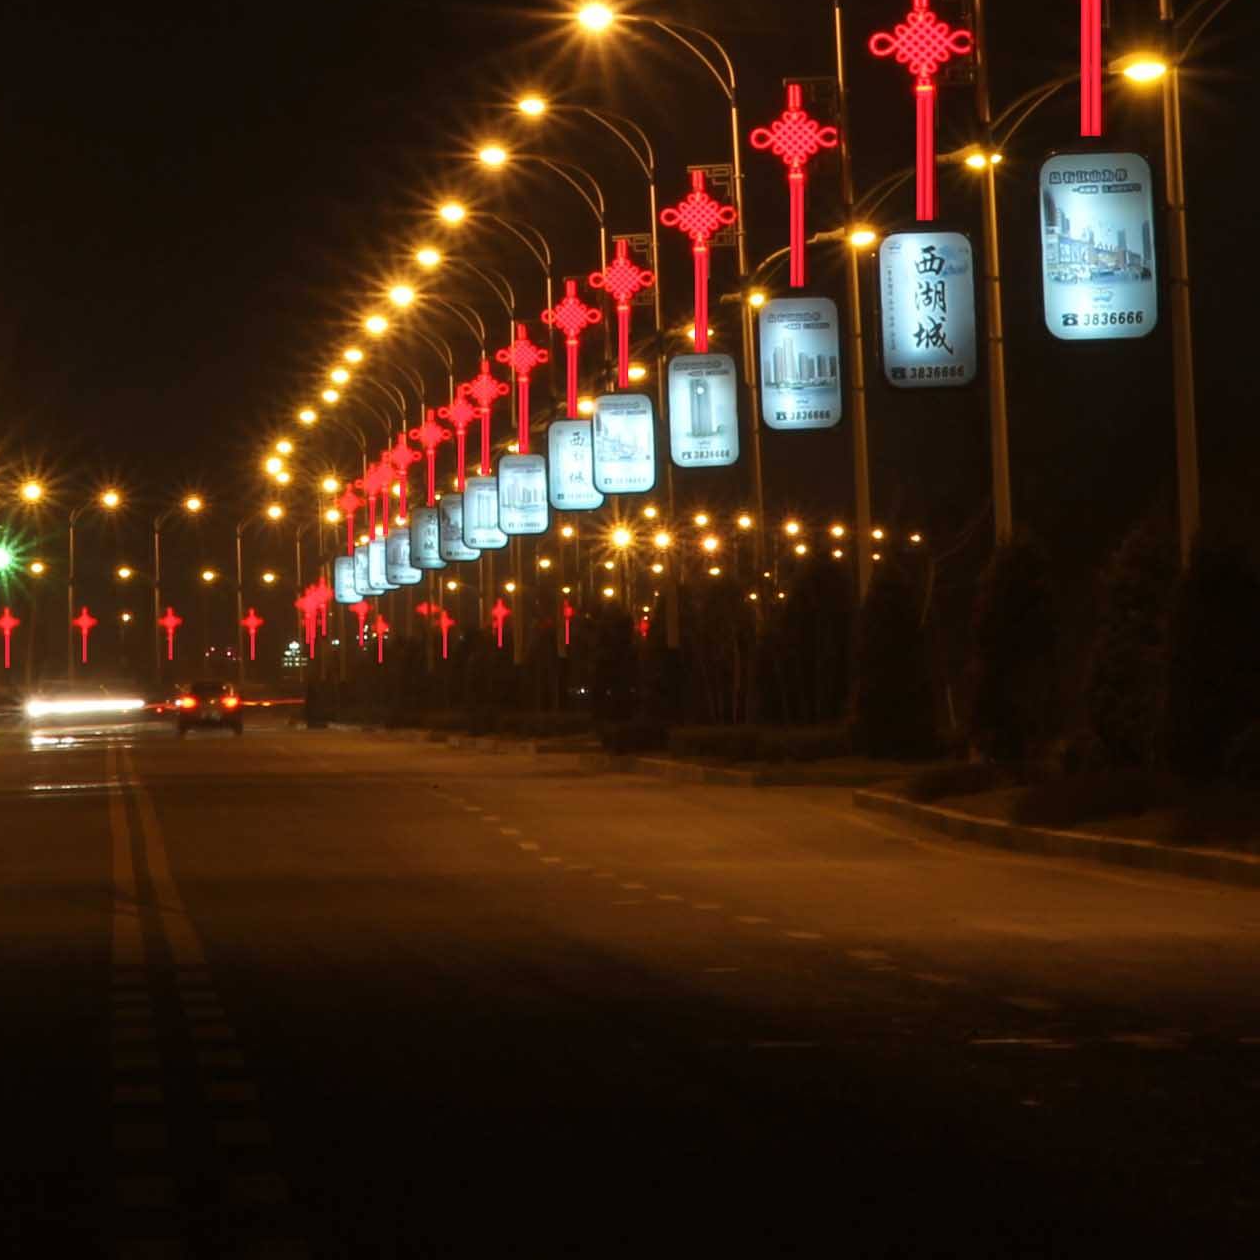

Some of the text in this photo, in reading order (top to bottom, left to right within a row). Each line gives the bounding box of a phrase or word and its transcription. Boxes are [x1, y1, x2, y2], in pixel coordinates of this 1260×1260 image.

[913, 245, 954, 356] 西湖城
[1083, 311, 1144, 326] 3836666
